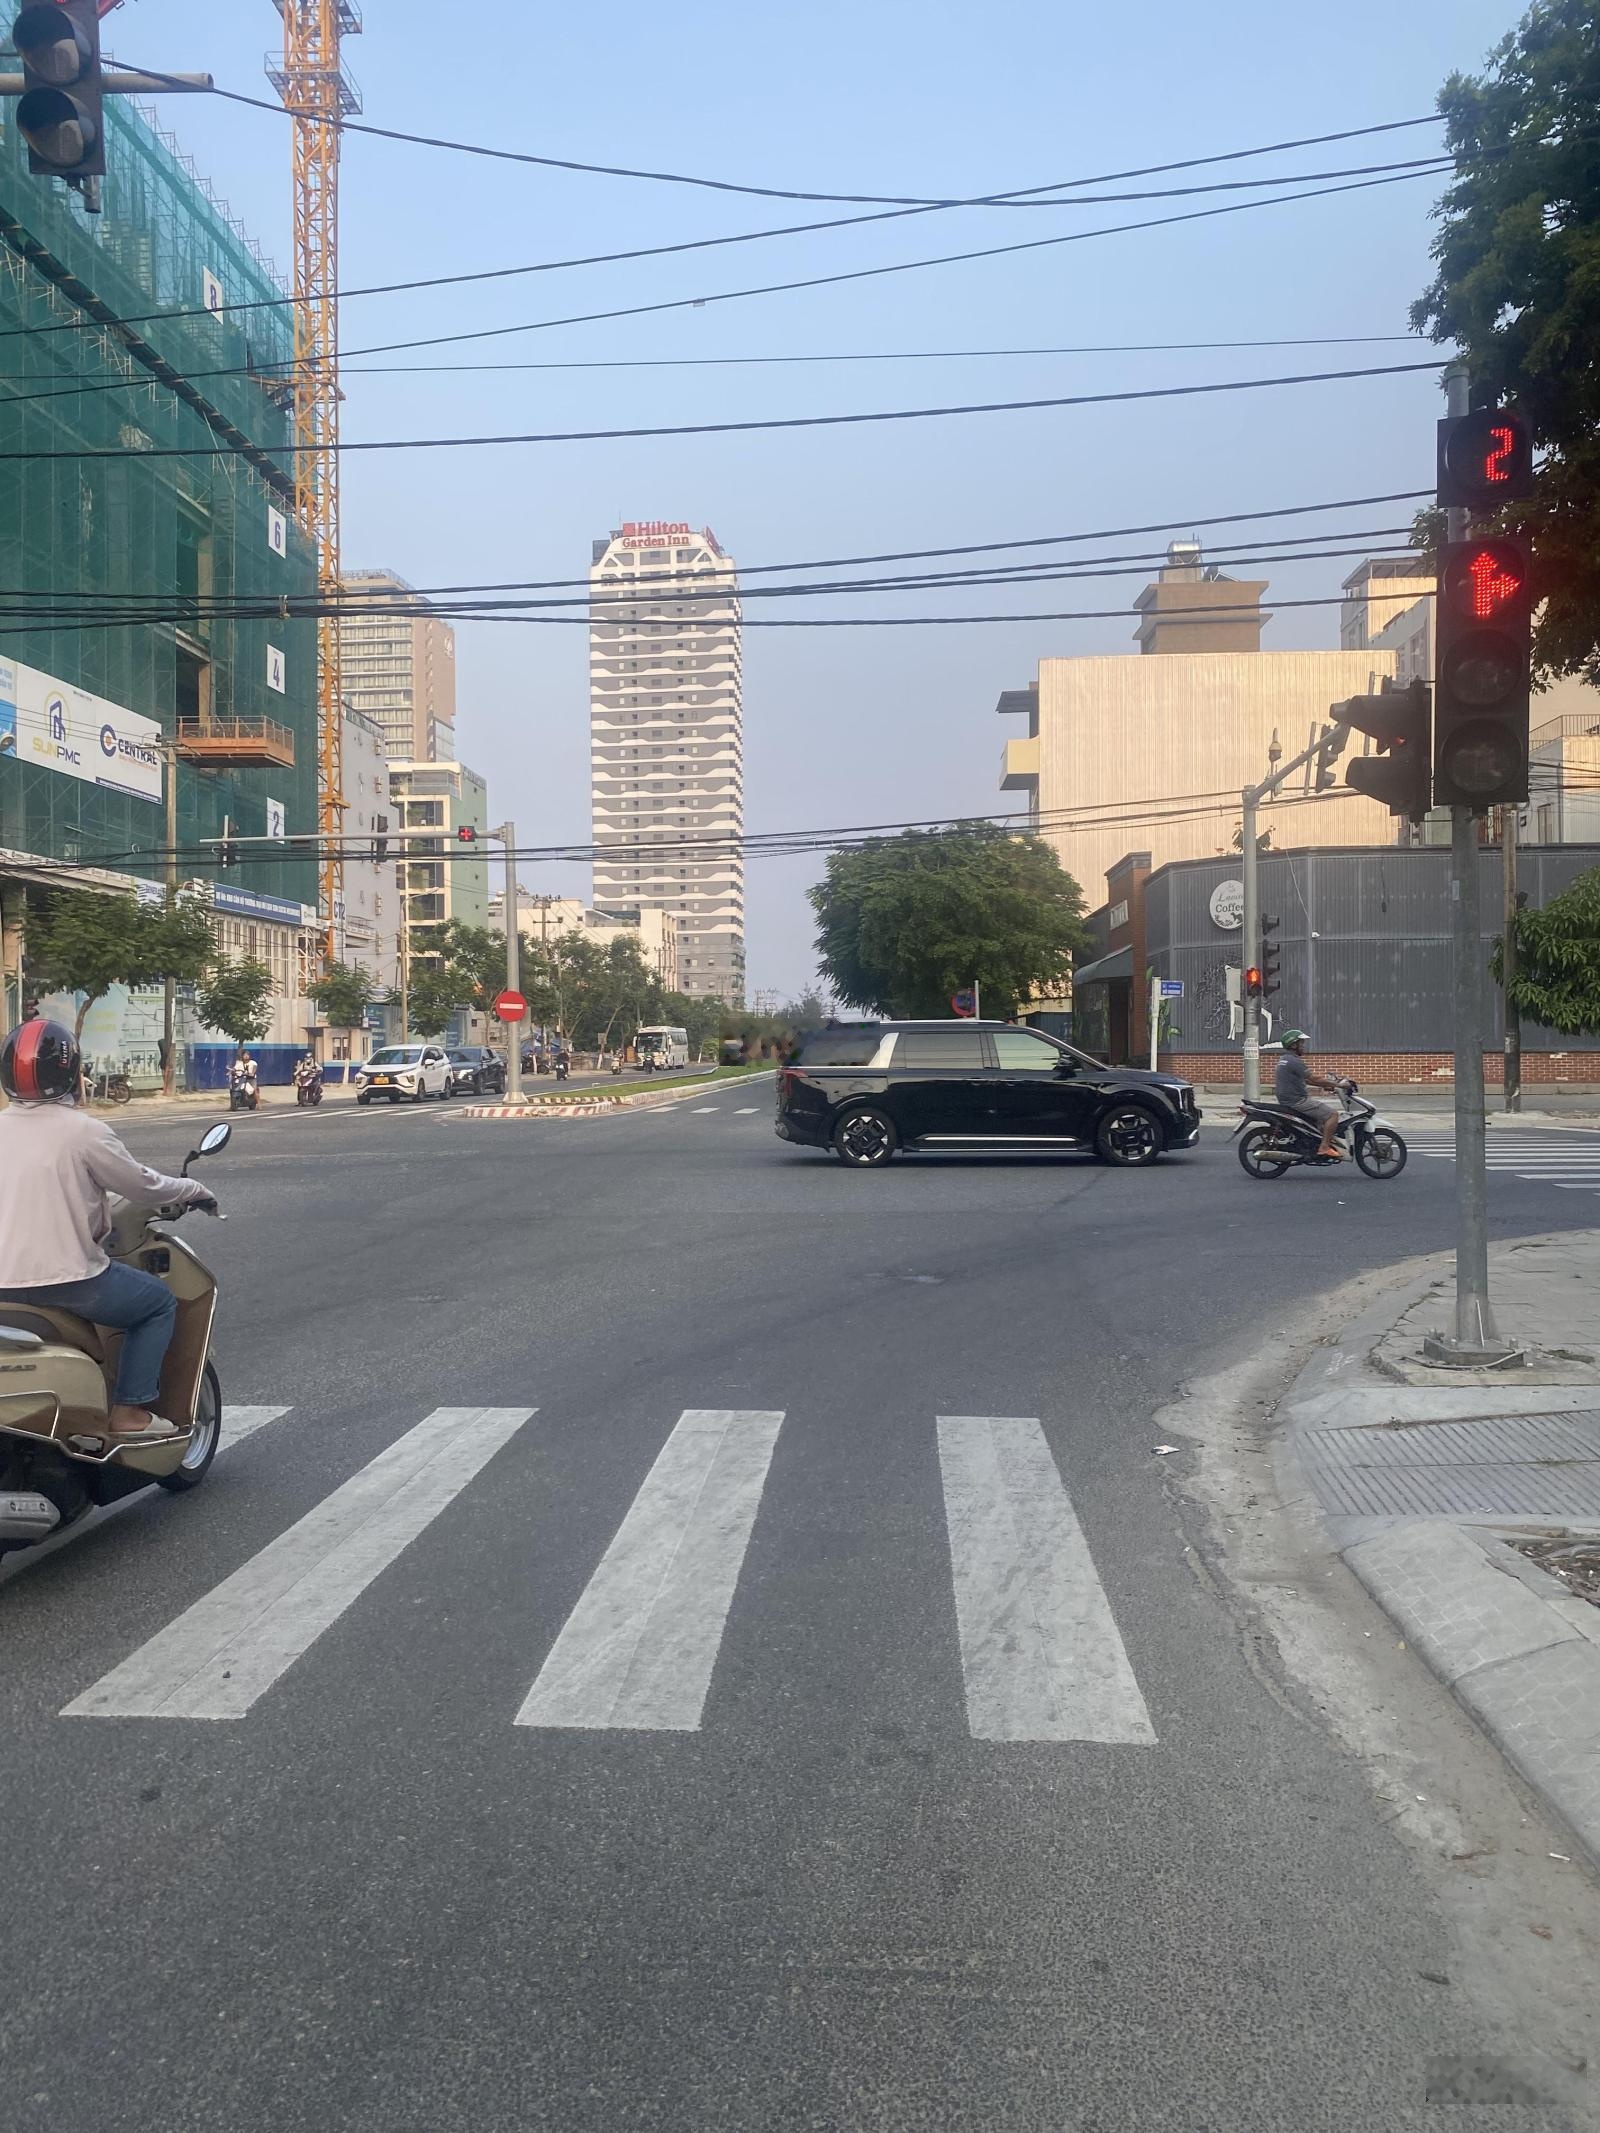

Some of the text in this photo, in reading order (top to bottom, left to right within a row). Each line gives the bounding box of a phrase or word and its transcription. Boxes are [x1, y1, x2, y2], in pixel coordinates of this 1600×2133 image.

[1485, 427, 1513, 481] 2
[274, 521, 281, 549] 6
[638, 520, 689, 536] Hilton
[622, 535, 690, 548] Garden Inn
[273, 658, 280, 687] 4
[118, 739, 157, 766] CENTRAL
[273, 811, 280, 837] 2
[0, 1364, 37, 1372] EAD
